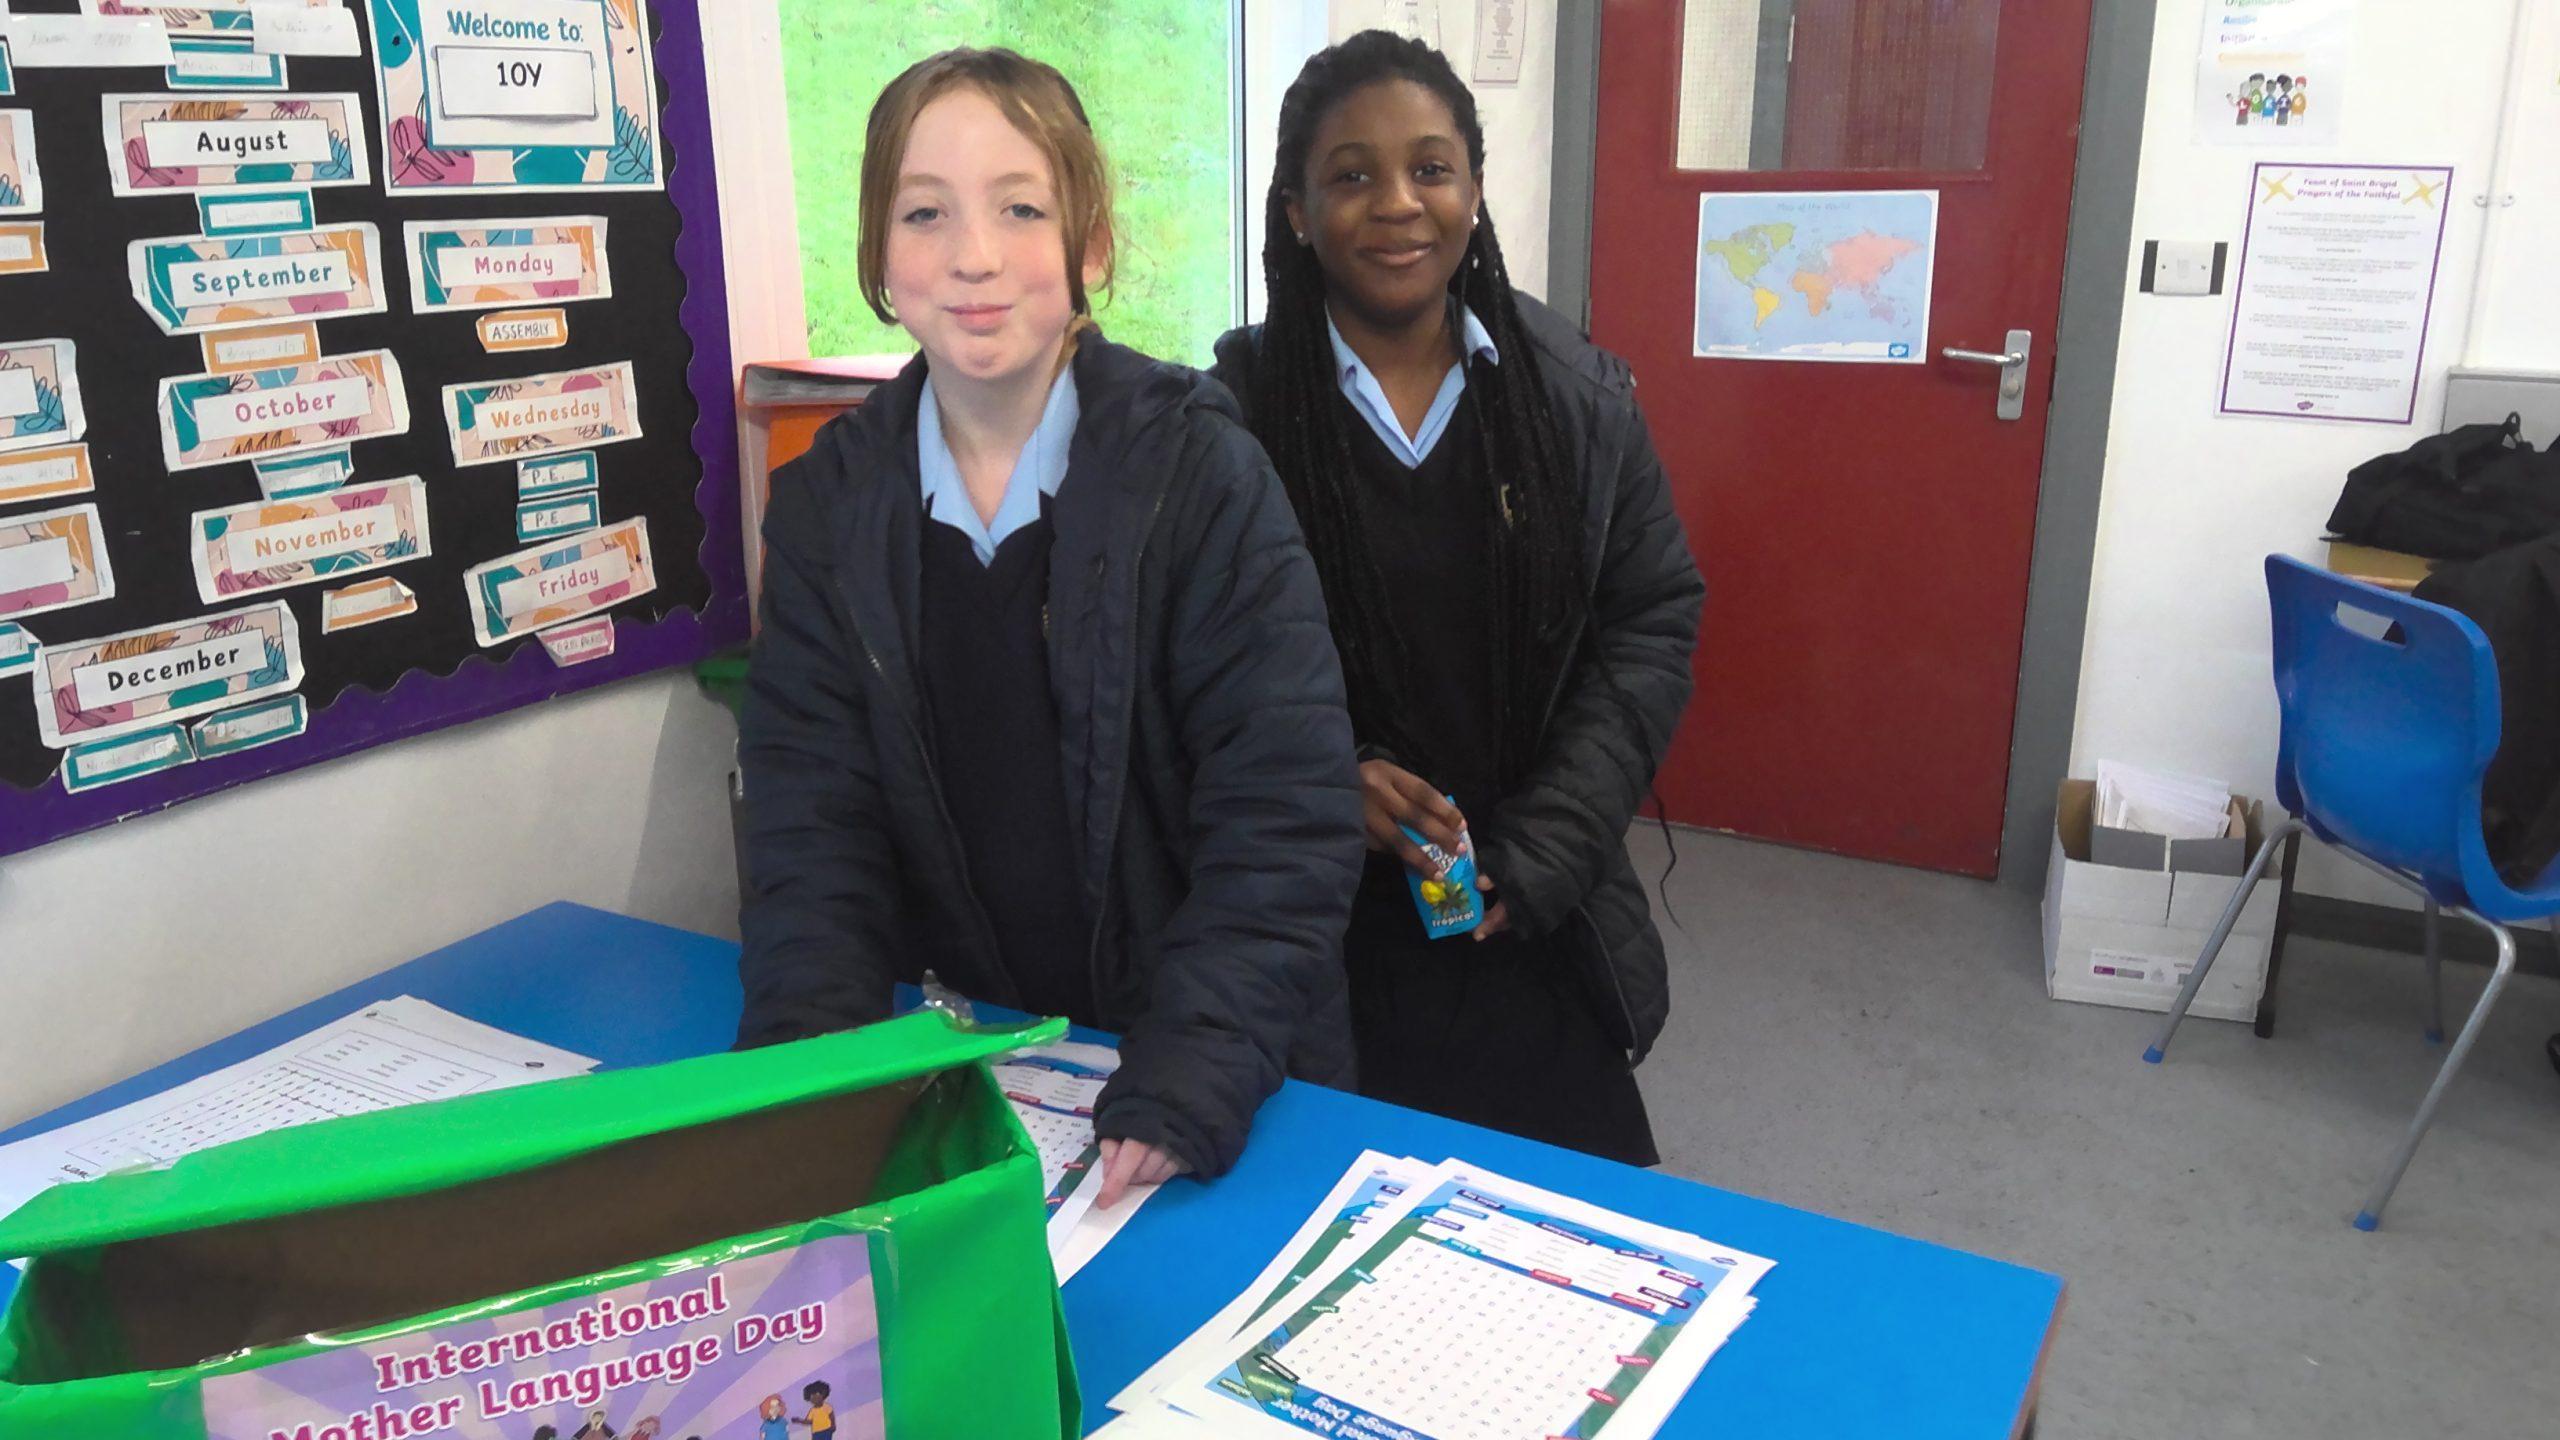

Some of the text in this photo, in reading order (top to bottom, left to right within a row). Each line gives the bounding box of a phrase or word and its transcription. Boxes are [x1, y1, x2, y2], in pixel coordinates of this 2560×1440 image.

[447, 10, 550, 39] Welcome
[497, 62, 542, 87] 10Y
[197, 130, 288, 156] August
[2297, 188, 2331, 198] Prayers
[2335, 190, 2344, 199] of
[2364, 191, 2401, 200] Faithful
[2303, 178, 2397, 188] Feast of Saint Brigid
[475, 253, 553, 275] Monday
[192, 262, 331, 296] September
[492, 322, 549, 341] ASSEMBLY
[235, 392, 335, 423] October
[491, 399, 600, 428] Wednesday
[255, 519, 376, 558] November
[539, 567, 599, 597] Friday
[108, 644, 239, 691] December
[376, 1276, 727, 1390] International
[483, 1335, 719, 1418] Language
[735, 1301, 825, 1357] Day
[1270, 1398, 1336, 1432] Mother
[1312, 1396, 1350, 1422] Day
